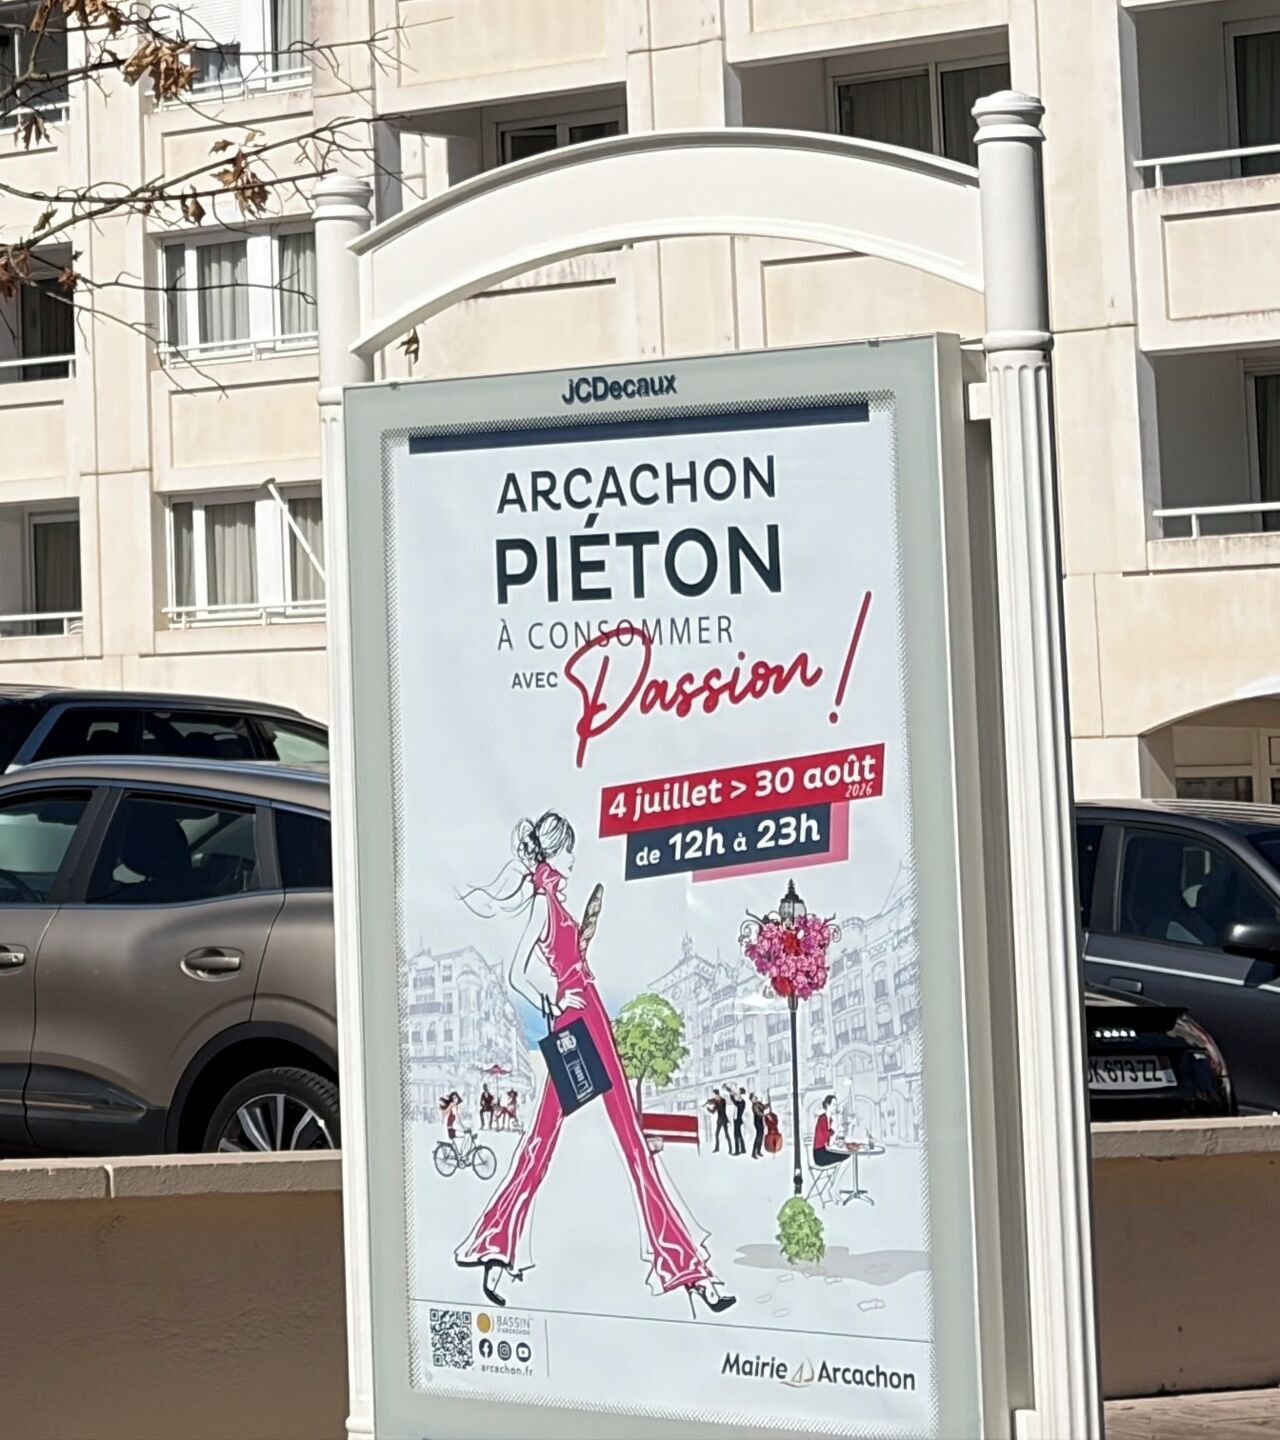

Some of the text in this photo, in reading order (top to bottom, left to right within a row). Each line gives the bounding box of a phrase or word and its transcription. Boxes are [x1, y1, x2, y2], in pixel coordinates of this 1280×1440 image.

[497, 455, 775, 514] ARCACHON
[496, 513, 782, 604] PIÉTON
[497, 615, 733, 651] À CONSOMMER
[511, 671, 558, 690] AVEC
[608, 792, 627, 818] 4
[633, 778, 722, 822] juillet
[755, 767, 794, 797] 30
[803, 753, 876, 789] août
[845, 782, 873, 798] 2026
[635, 813, 820, 867] de 12h à 23h
[481, 1363, 533, 1376] arcachon.fr
[721, 1352, 916, 1391] Mairie Arcachon
